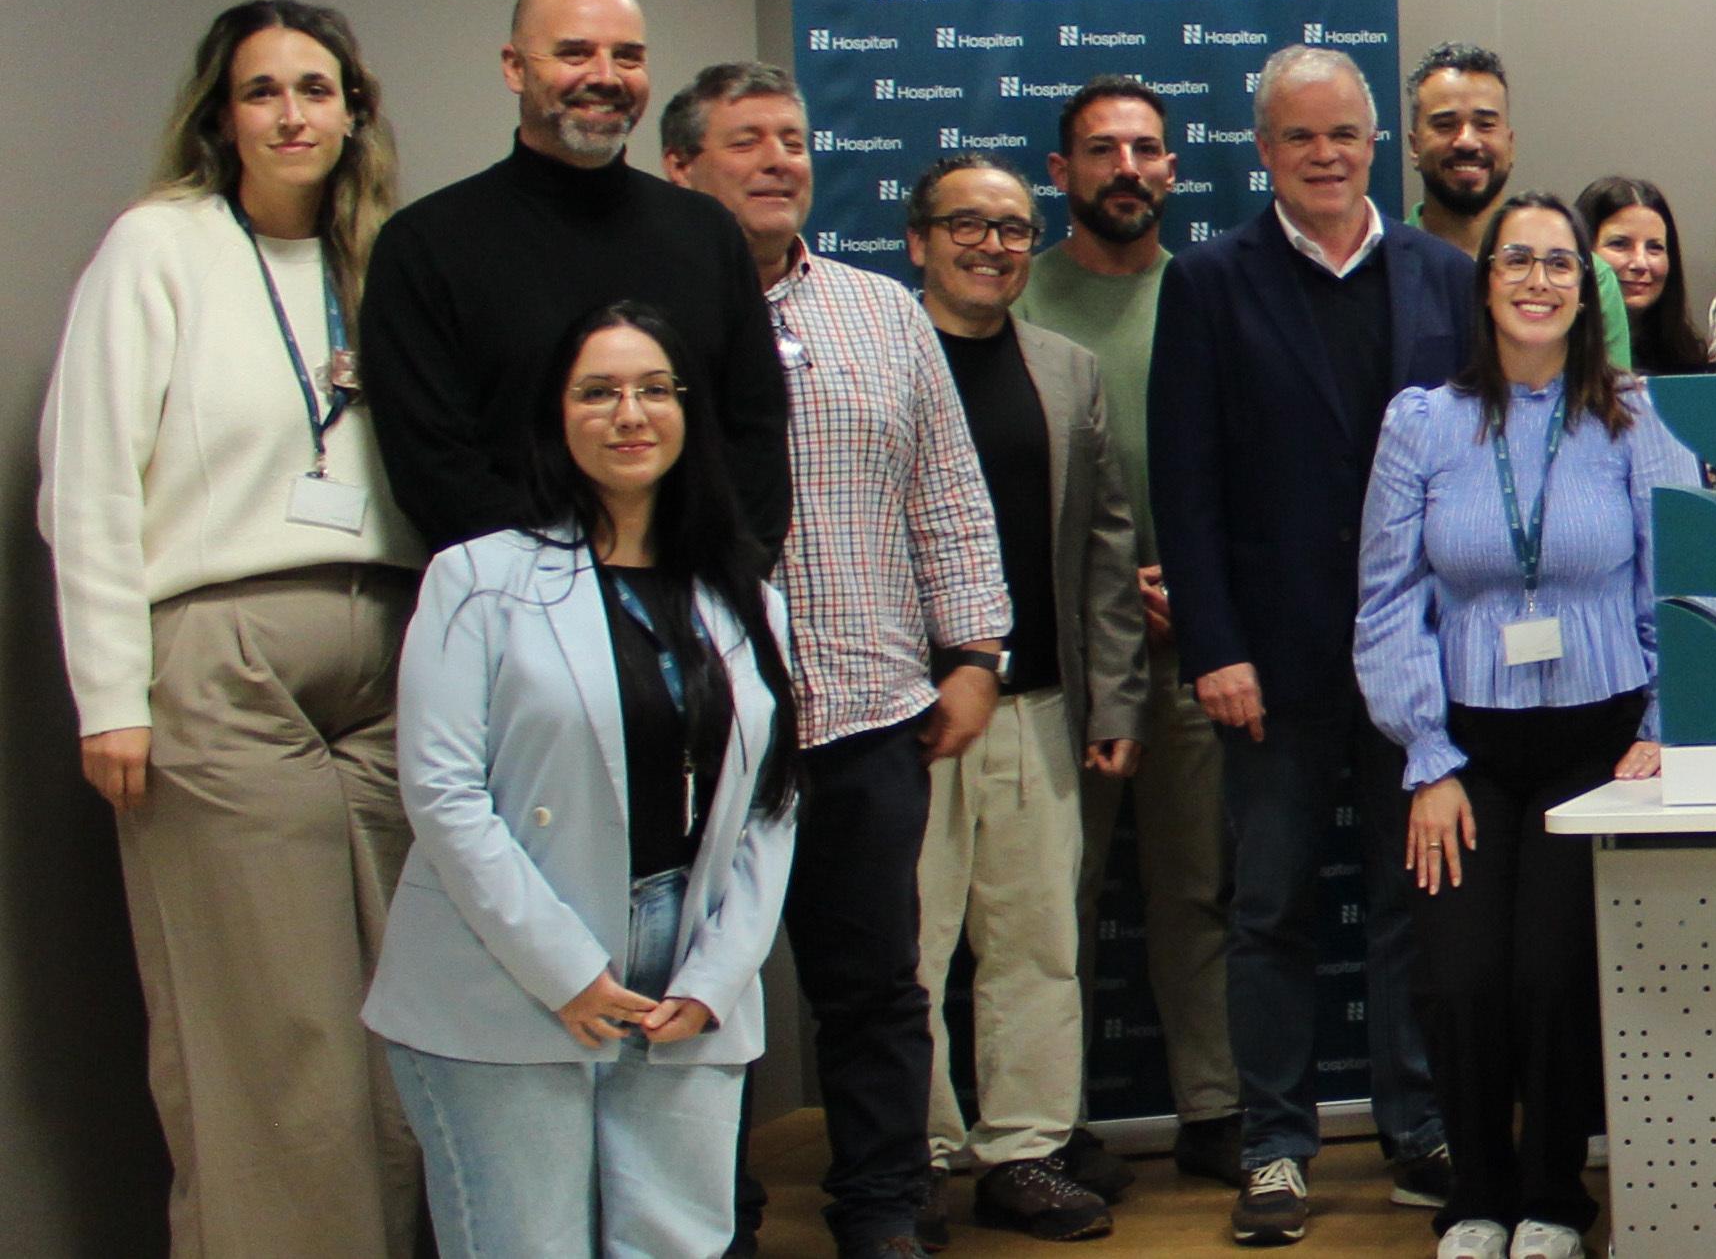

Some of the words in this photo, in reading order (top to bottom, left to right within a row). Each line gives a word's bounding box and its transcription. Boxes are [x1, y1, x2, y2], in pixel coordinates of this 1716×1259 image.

[832, 36, 898, 51] Hospiten
[958, 34, 1023, 49] Hospiten
[1082, 32, 1145, 47] Hospiten
[1205, 31, 1267, 46] Hospiten
[1325, 30, 1387, 45] Hospiten
[898, 85, 962, 100] Hospiten
[1145, 81, 1209, 96] Hospiten
[836, 137, 902, 152] Hospiten
[962, 134, 1026, 149] Hospiten
[1208, 129, 1256, 145] Hospit
[840, 238, 905, 253] Hospiten
